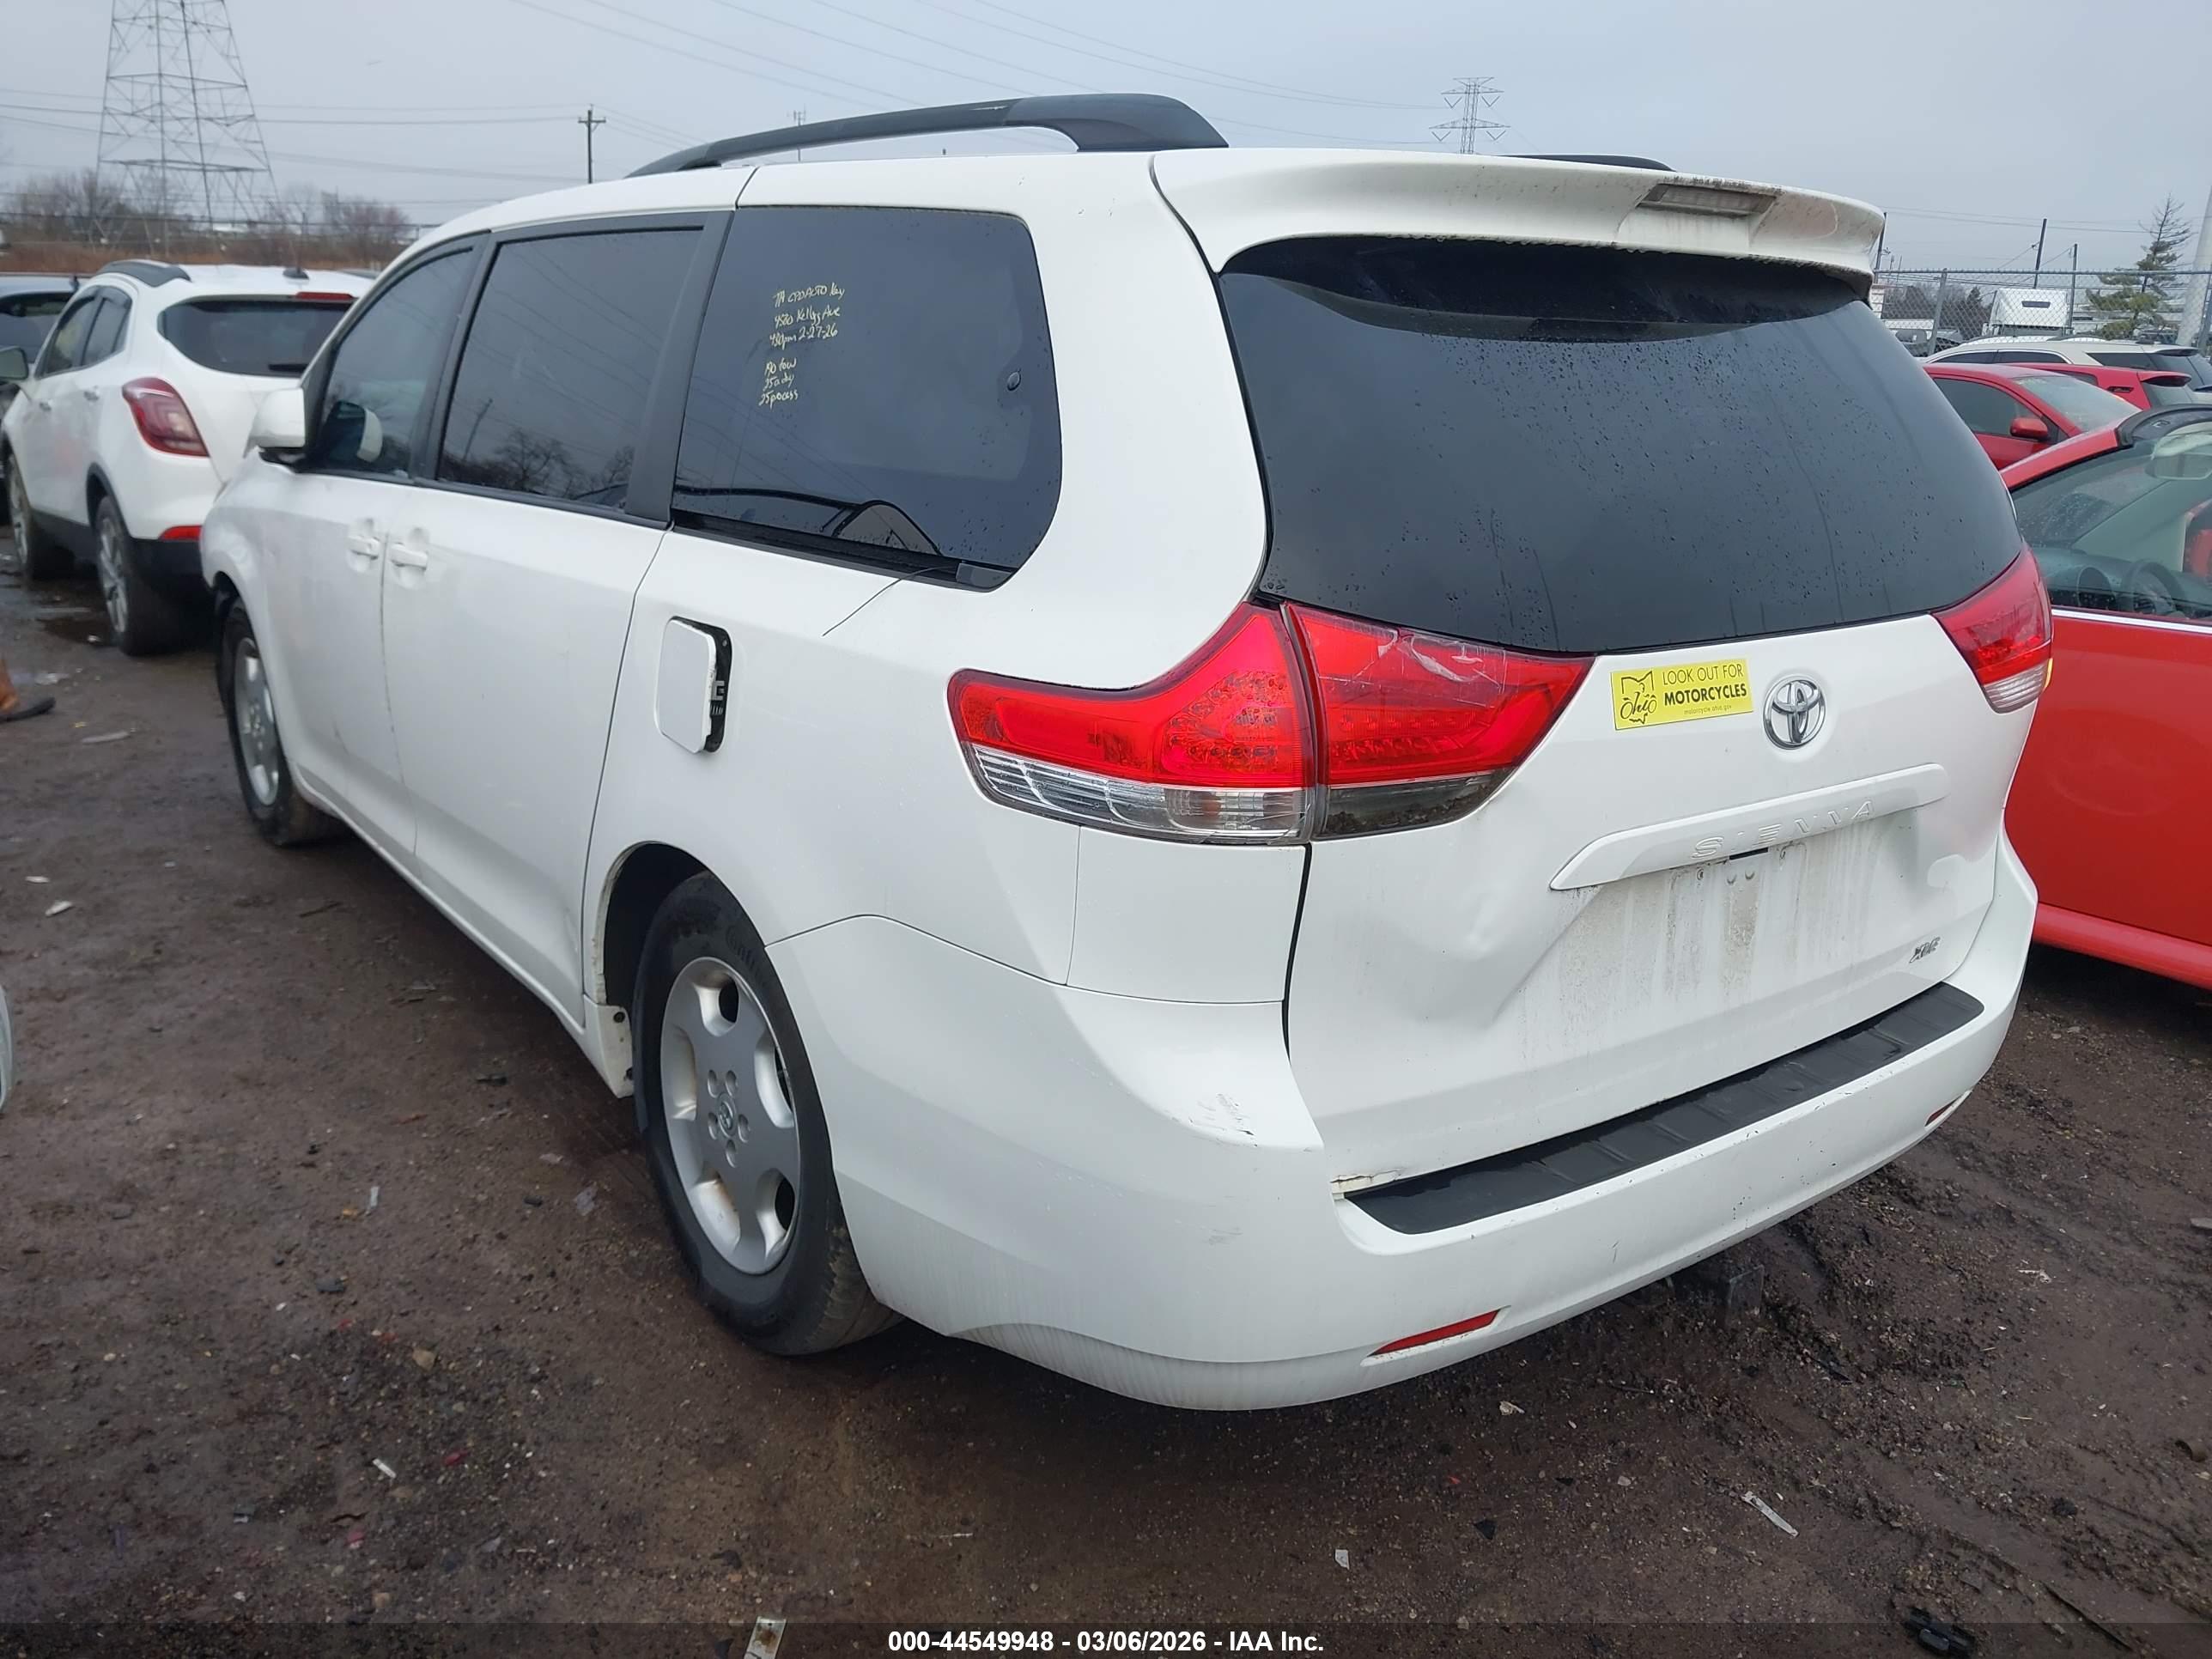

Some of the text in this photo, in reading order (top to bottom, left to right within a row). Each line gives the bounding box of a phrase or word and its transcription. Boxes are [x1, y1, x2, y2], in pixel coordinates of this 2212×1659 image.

[1662, 664, 1744, 685] LOOK OUT FOR
[1664, 683, 1747, 706] MOTORCYCLES
